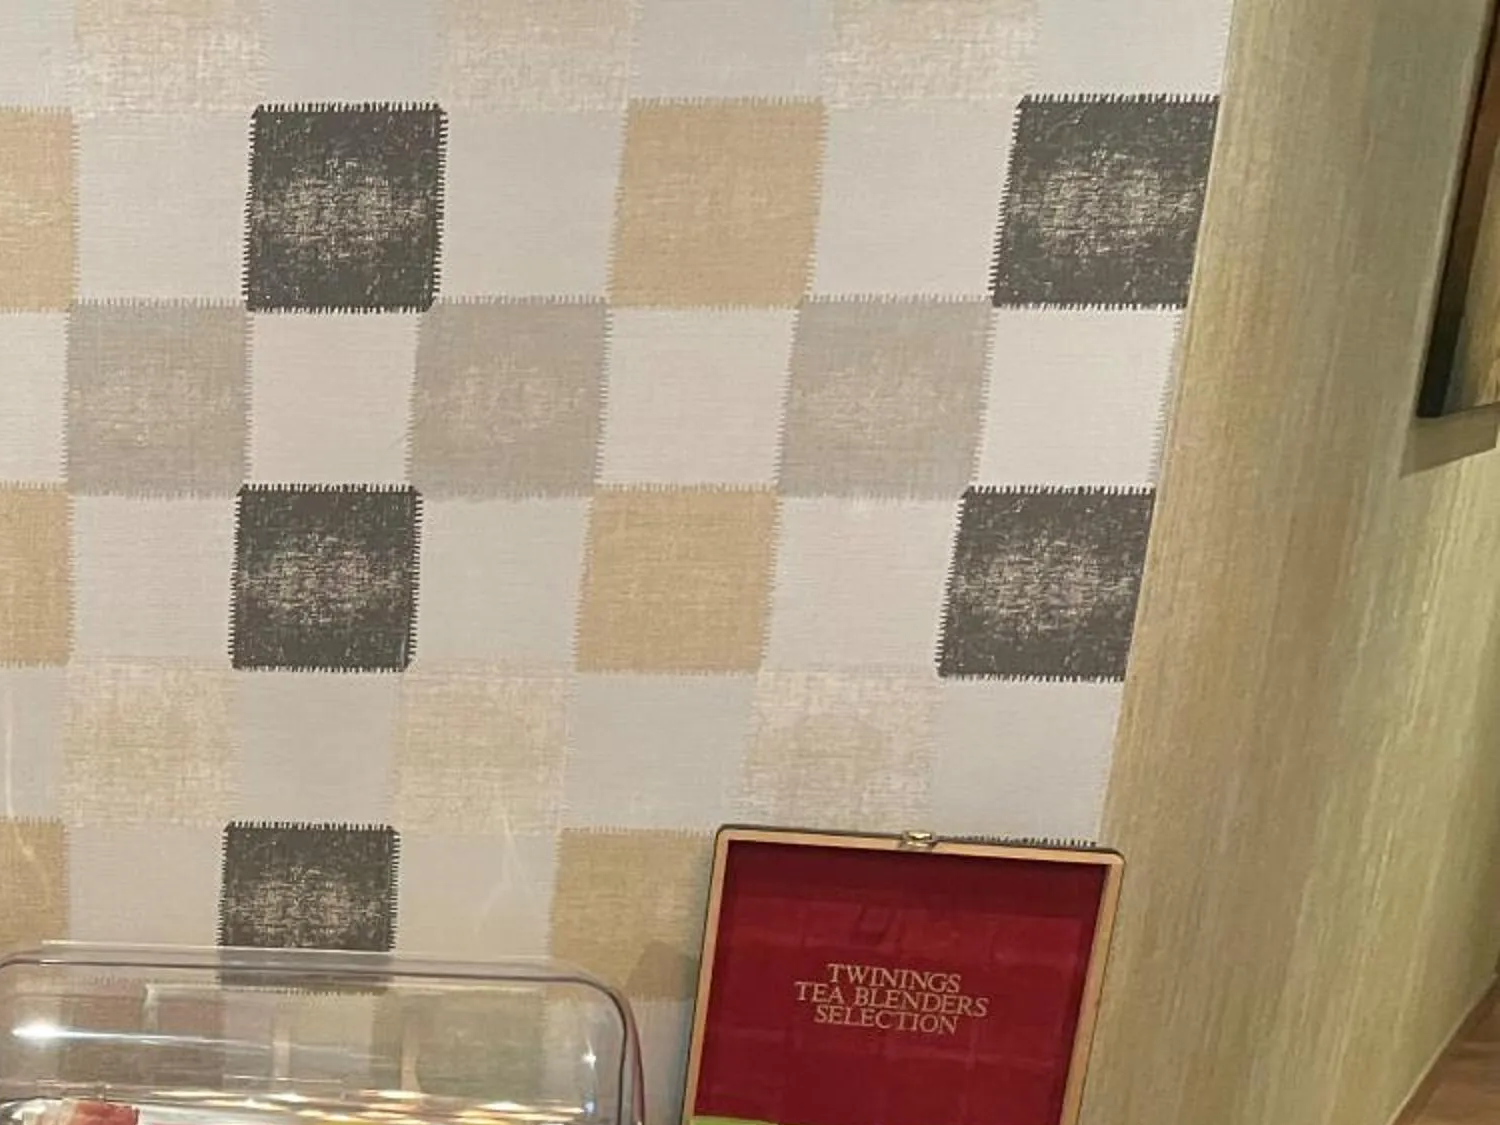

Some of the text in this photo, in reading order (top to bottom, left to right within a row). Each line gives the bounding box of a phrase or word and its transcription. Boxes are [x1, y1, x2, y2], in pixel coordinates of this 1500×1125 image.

[827, 963, 961, 993] TWININGS
[794, 981, 989, 1018] TEA BLENDERS
[814, 1004, 959, 1035] SELECTION
